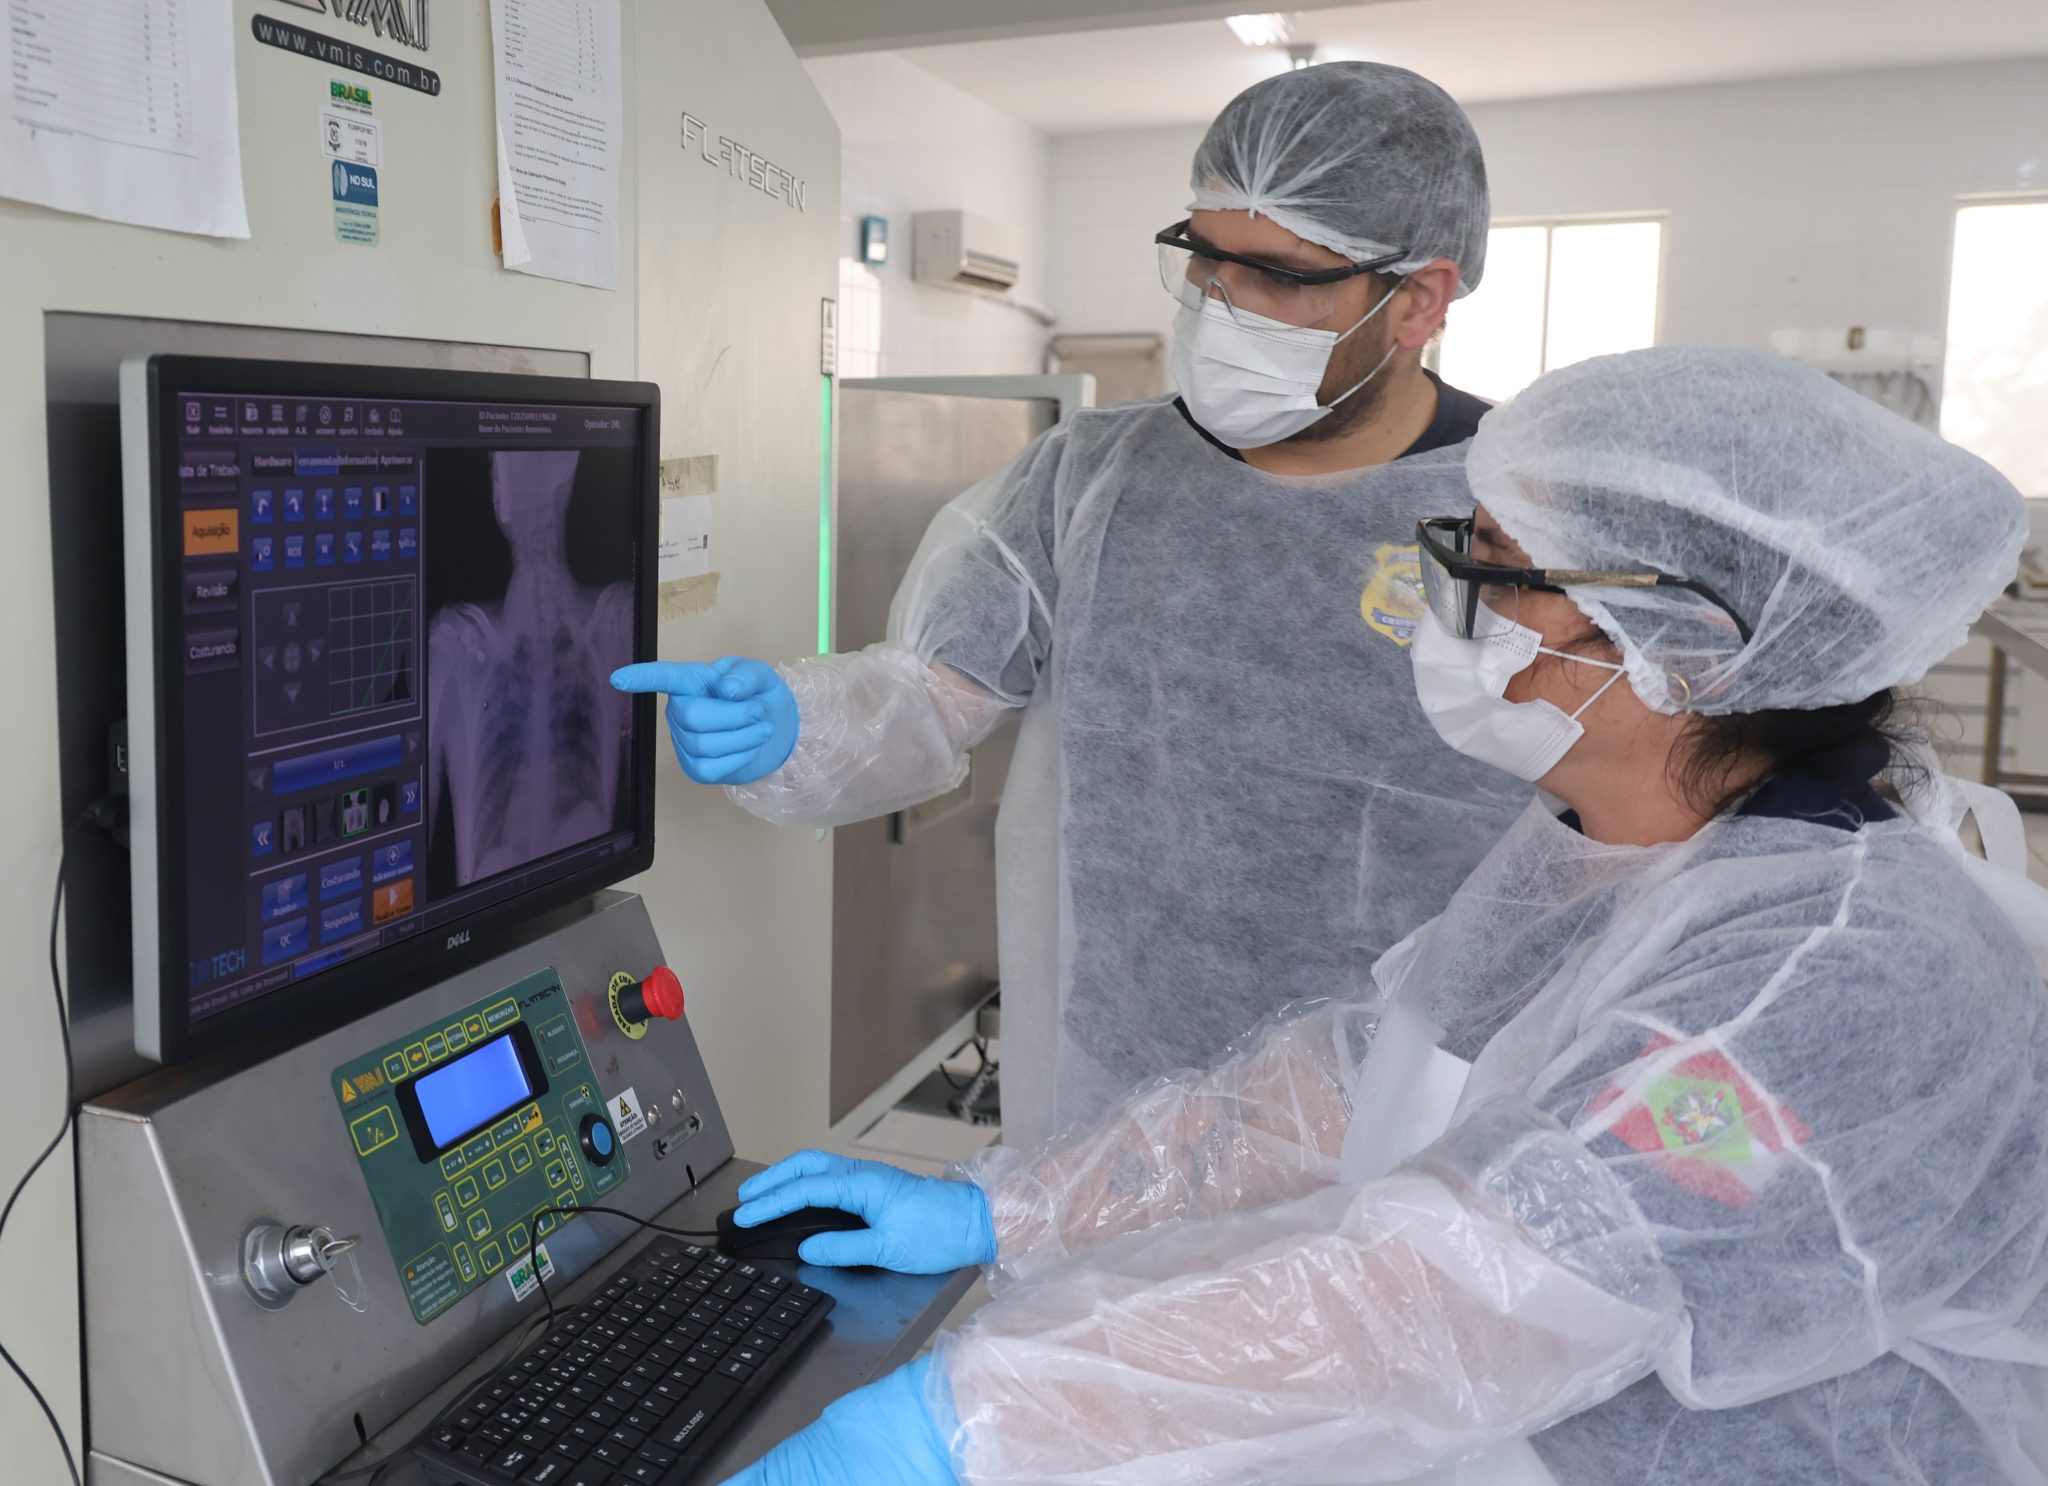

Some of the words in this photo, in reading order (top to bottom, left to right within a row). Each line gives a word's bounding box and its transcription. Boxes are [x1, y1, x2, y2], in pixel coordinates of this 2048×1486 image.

[258, 23, 438, 92] www.vmis.com.br
[330, 80, 372, 106] BRASIL
[681, 111, 806, 213] FLATSCAN
[254, 456, 293, 468] Hardware
[192, 523, 230, 539] Aquisição
[196, 582, 228, 598] Revisão
[189, 642, 236, 659] Costurando
[321, 868, 361, 889] Costurando
[611, 979, 620, 992] DE
[611, 995, 631, 1034] PARADA
[511, 1251, 548, 1289] BRAIL
[673, 1409, 705, 1443] MULTILASER
